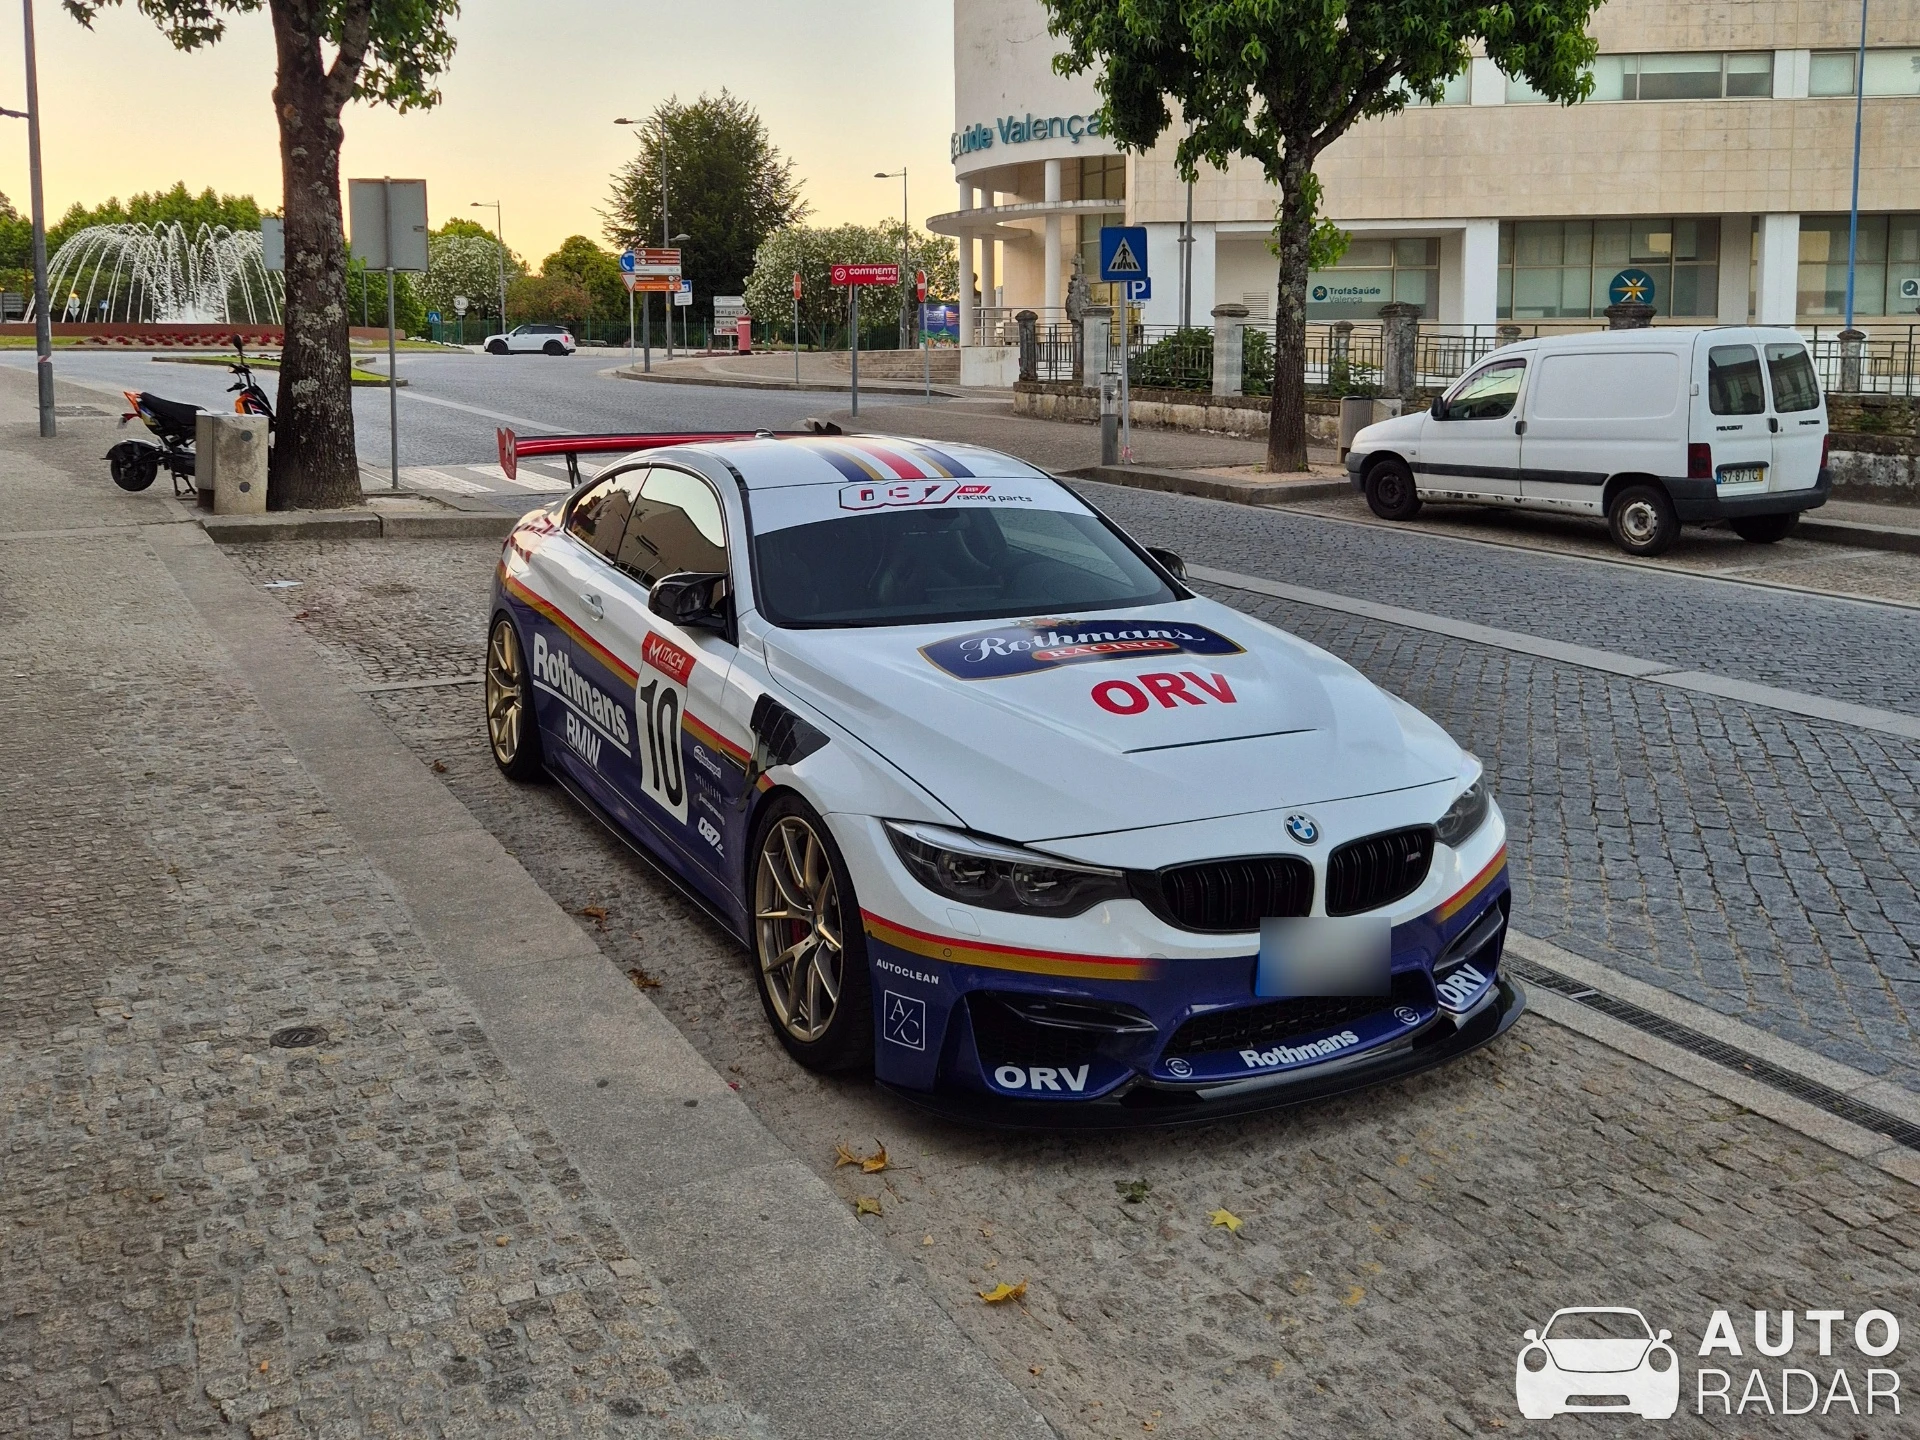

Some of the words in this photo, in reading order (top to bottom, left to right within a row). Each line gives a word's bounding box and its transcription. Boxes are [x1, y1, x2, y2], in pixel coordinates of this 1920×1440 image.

[997, 113, 1101, 144] Valença
[849, 267, 897, 276] CONTINENTE
[1132, 281, 1146, 299] P
[1329, 287, 1381, 295] TrofaSaúde
[1329, 296, 1363, 304] Valença
[1722, 469, 1758, 482] 67-87-TC
[957, 494, 996, 502] racing
[998, 495, 1033, 503] parts
[649, 639, 687, 671] MITACHI
[959, 627, 1206, 663] Rothmans
[1048, 640, 1165, 658] RACING
[533, 632, 631, 745] Rothmans
[1091, 671, 1238, 715] ORV
[566, 713, 602, 770] BMW
[641, 679, 682, 807] 10
[876, 958, 939, 985] AUTOCLEAN
[1436, 963, 1488, 1004] ORV
[1239, 1030, 1360, 1069] Rothmans
[994, 1064, 1090, 1092] ORV
